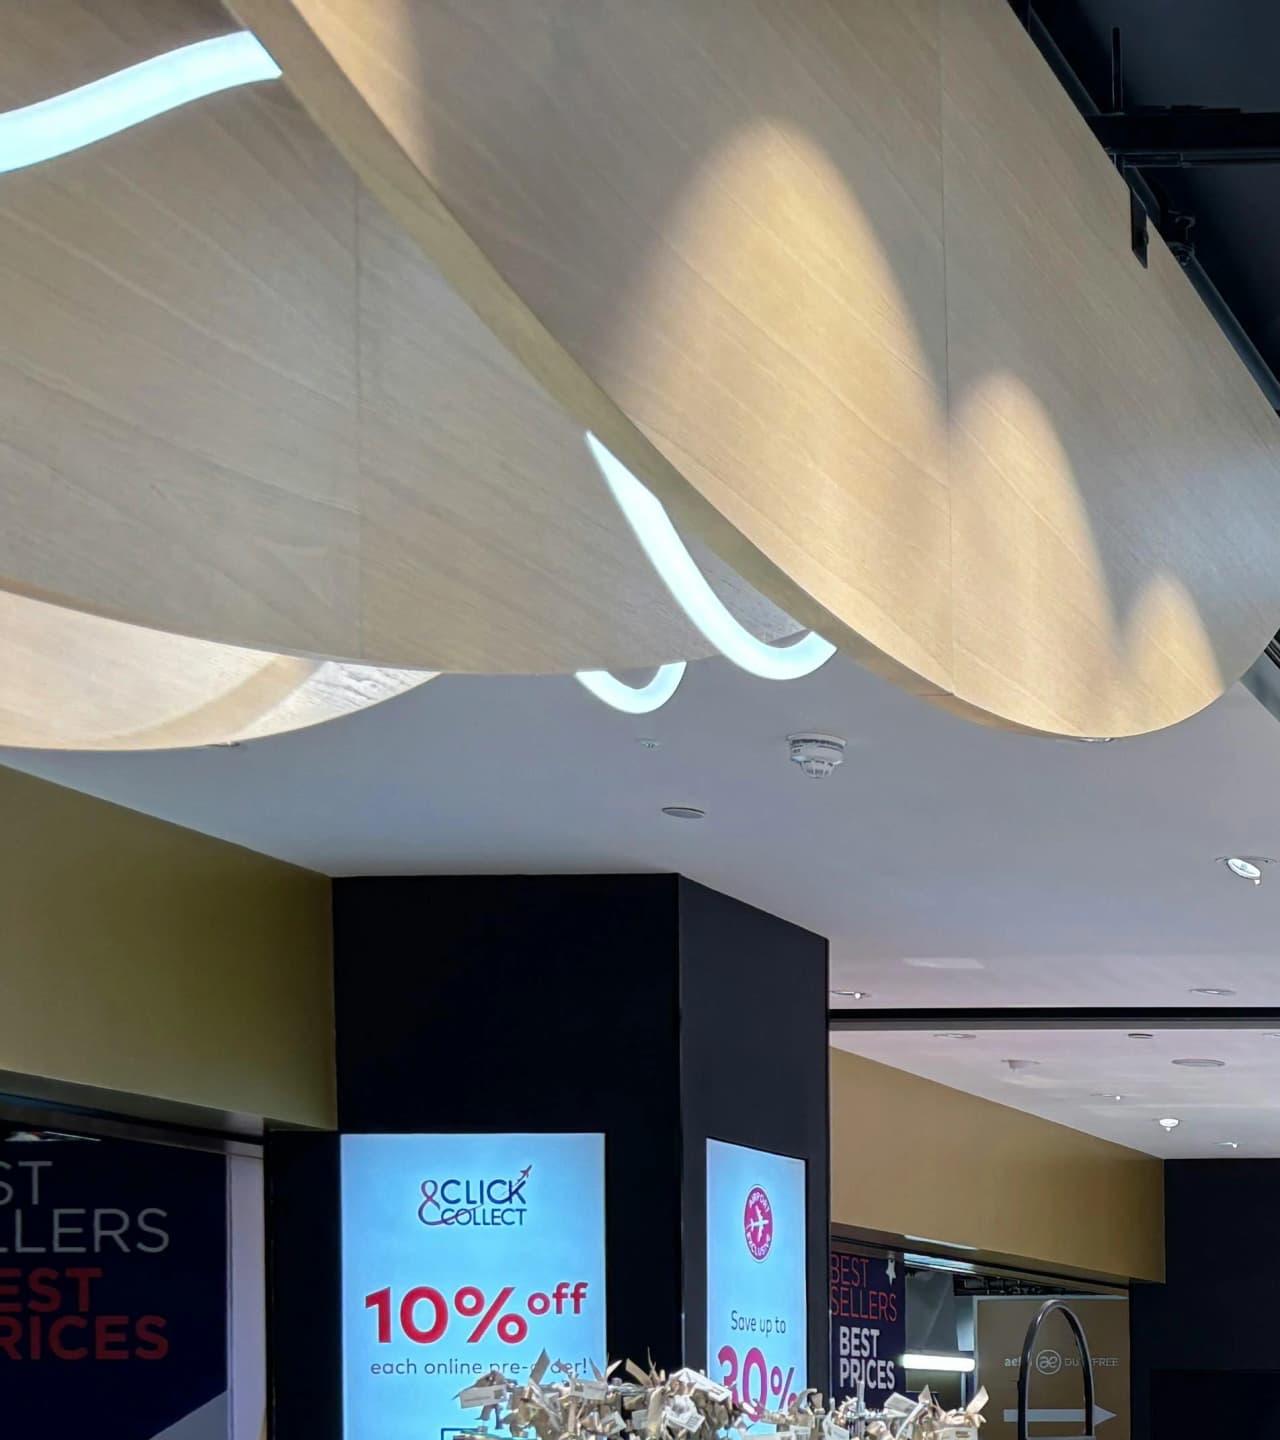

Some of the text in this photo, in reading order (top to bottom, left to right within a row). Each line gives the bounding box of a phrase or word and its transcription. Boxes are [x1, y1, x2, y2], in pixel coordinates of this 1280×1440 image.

[440, 1179, 527, 1205] CLICK
[0, 1208, 170, 1253] LERS
[441, 1208, 527, 1226] COLLECT
[831, 1253, 869, 1288] BEST
[364, 1282, 588, 1344] 10% off
[831, 1286, 897, 1322] SELLERS
[731, 1310, 786, 1338] Save up to
[839, 1326, 880, 1358] BEST
[370, 1359, 417, 1374] each
[424, 1359, 482, 1374] online
[839, 1358, 895, 1390] PRICES
